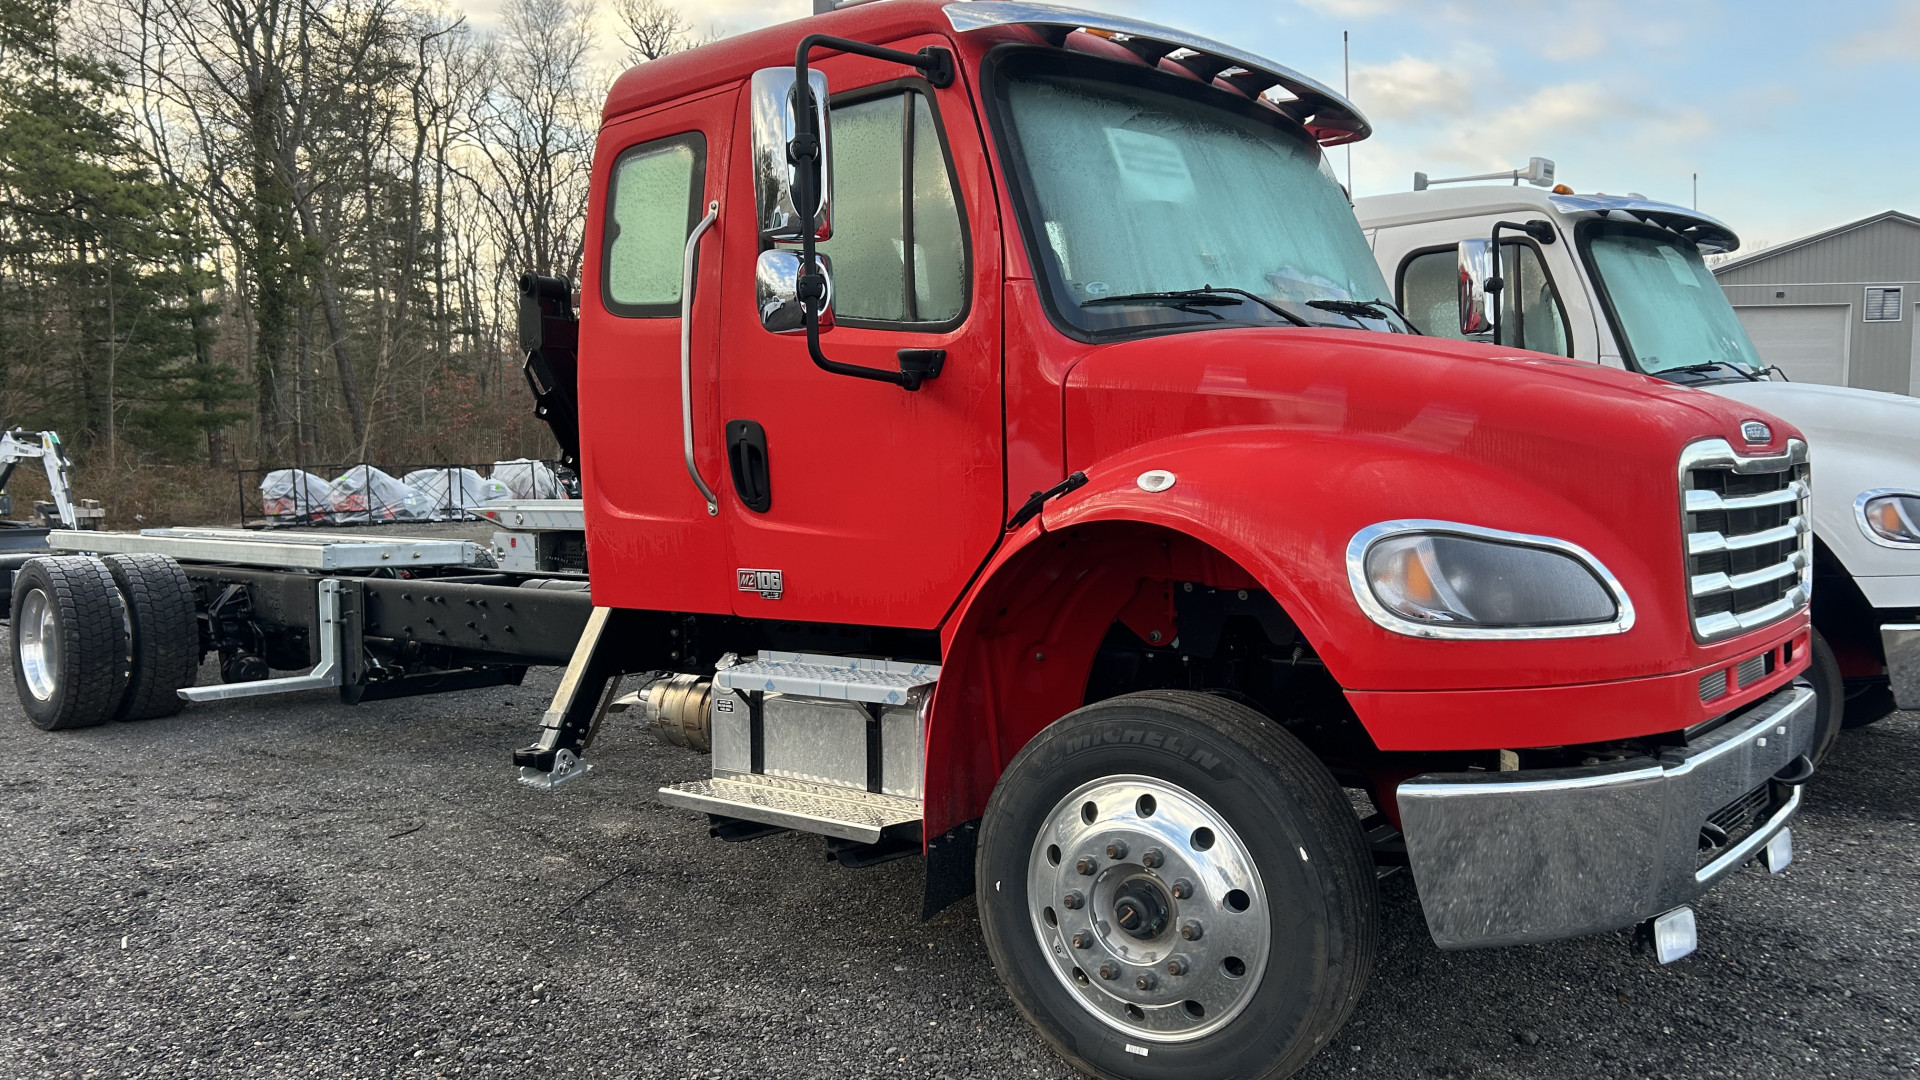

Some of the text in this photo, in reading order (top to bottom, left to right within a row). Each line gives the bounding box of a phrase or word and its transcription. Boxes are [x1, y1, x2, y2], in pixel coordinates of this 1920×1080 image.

[1745, 426, 1770, 437] FREIGHTL
[740, 572, 780, 589] M2 106
[1066, 728, 1222, 770] MICHELIN
